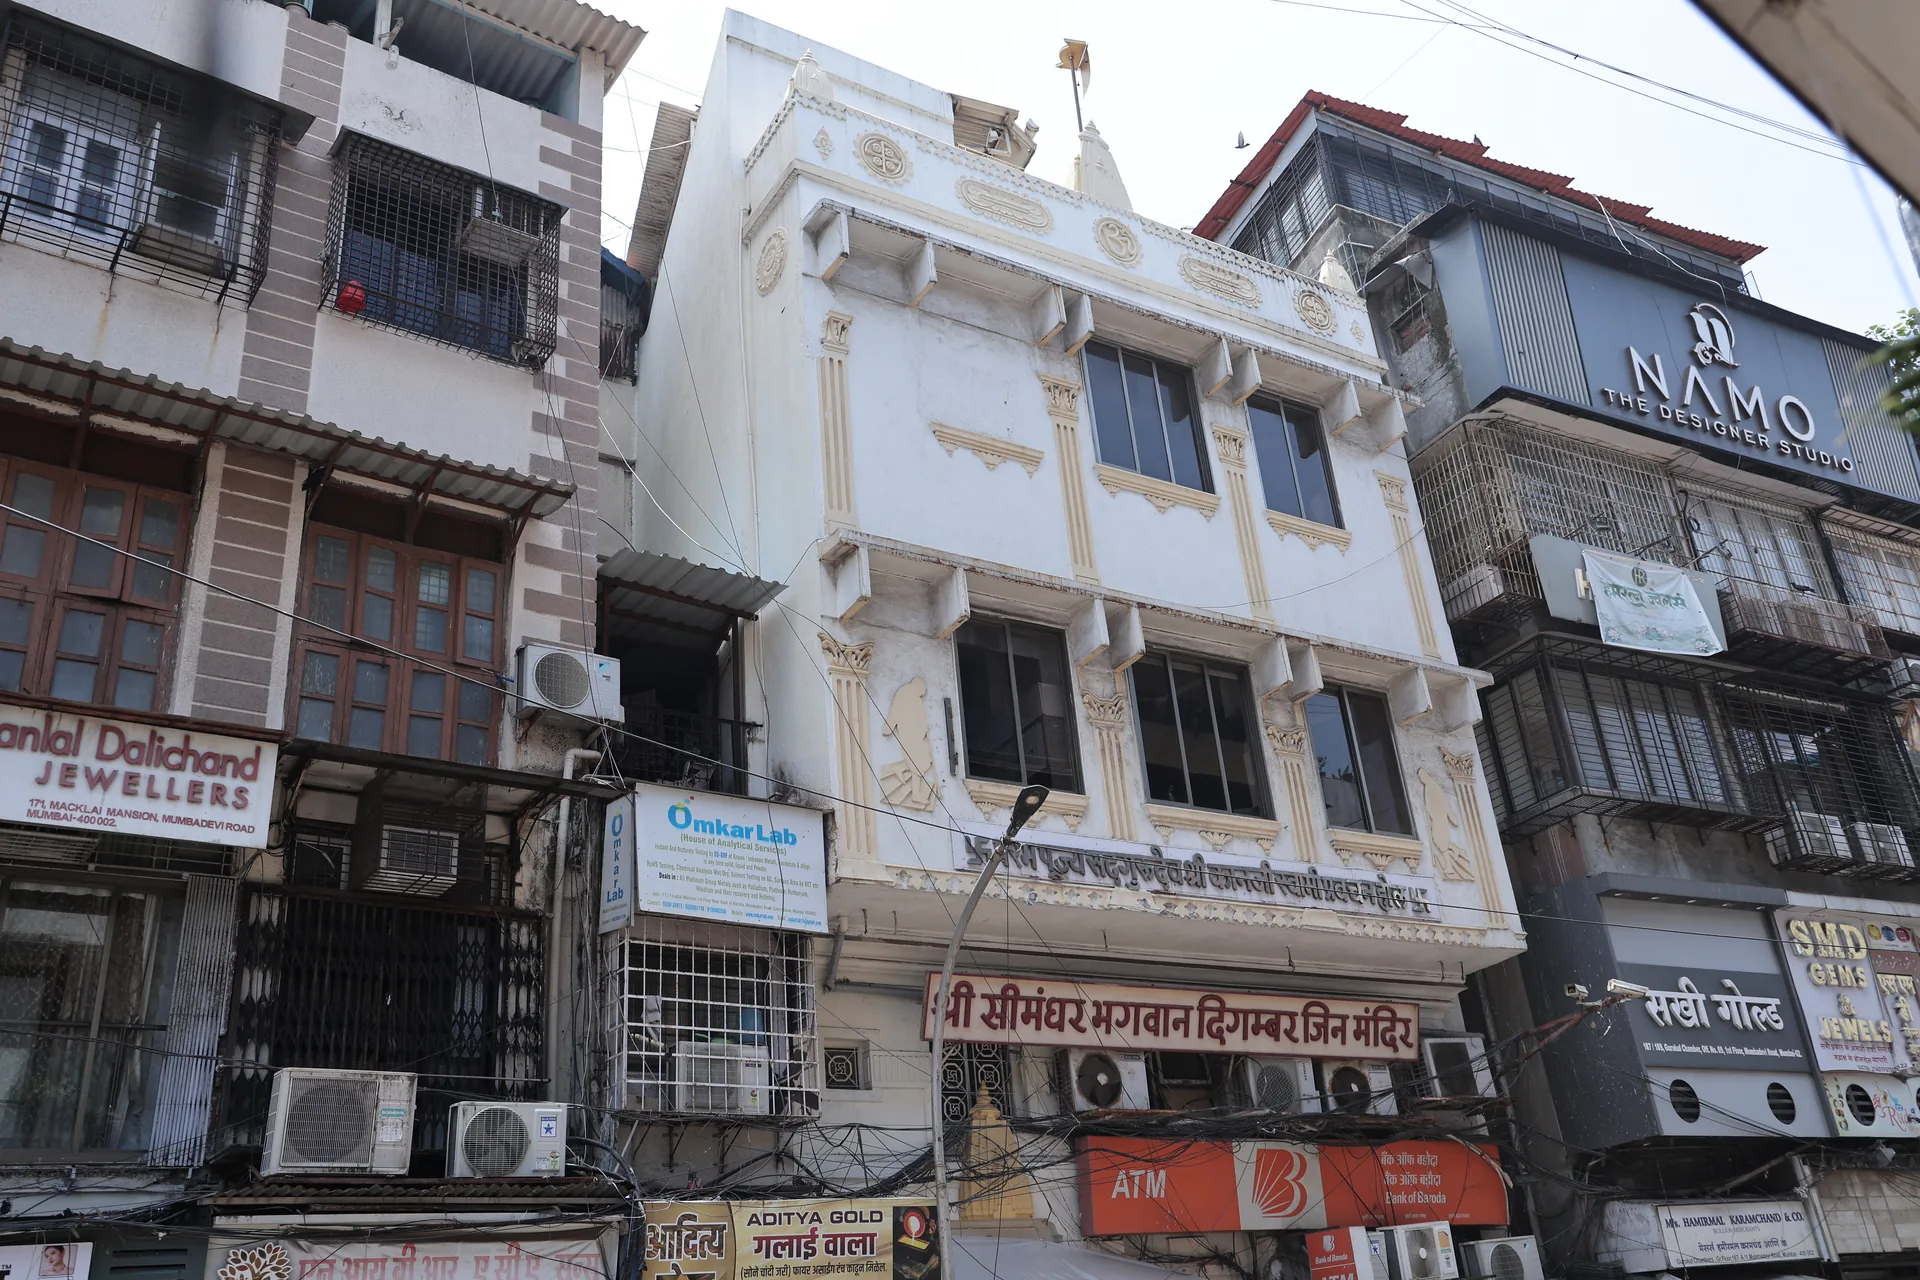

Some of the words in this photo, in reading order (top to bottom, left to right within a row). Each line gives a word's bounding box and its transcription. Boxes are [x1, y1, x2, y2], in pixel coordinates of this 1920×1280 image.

[1626, 346, 1815, 442] NAMO
[1601, 387, 1651, 414] THE
[1657, 404, 1771, 449] DESIGNER
[1779, 439, 1854, 472] STUDIO
[95, 724, 262, 781] Dalichand
[34, 760, 250, 810] JEWELLERS
[29, 798, 47, 810] 171,
[49, 800, 103, 815] MACKLAI
[106, 807, 160, 823] MANSION,
[161, 814, 225, 830] MUMBADEVI
[225, 822, 255, 834] ROAD
[667, 802, 754, 840] Omkar
[756, 823, 797, 846] Lab
[680, 833, 705, 844] (House
[708, 837, 715, 845] of
[717, 837, 753, 850] Analytical
[754, 842, 787, 856] Services)
[658, 872, 671, 880] Deals
[1183, 852, 1207, 889] श्री
[1207, 859, 1275, 895] कानजी
[1274, 865, 1324, 901] स्वामी
[606, 887, 624, 903] Lab
[1786, 919, 1867, 960] SMD
[1807, 962, 1868, 989] GEMS
[932, 981, 976, 1028] श्री
[980, 983, 1087, 1034] सीमंधर
[1091, 999, 1194, 1038] भगवान
[1197, 994, 1299, 1046] दिगम्बर
[1301, 1000, 1349, 1046] जिन
[1353, 1005, 1414, 1052] मंदिर
[1645, 976, 1711, 1029] सखी
[1710, 979, 1784, 1032] गोल्ड
[1838, 992, 1857, 1016] &
[1818, 1015, 1893, 1043] JEWELS
[1743, 1047, 1768, 1056] Mumbadevi
[1767, 1048, 1780, 1058] Road,
[1112, 1168, 1167, 1200] ATM
[1385, 1191, 1407, 1204] Bank
[1408, 1190, 1417, 1204] of
[1417, 1190, 1447, 1204] Baroda
[747, 1211, 823, 1226] ADITYA
[830, 1210, 884, 1224] GOLD
[1683, 1215, 1726, 1228] HAMIRMAL
[1729, 1213, 1782, 1226] KARAMCHAND
[1784, 1212, 1792, 1223] &
[1791, 1211, 1805, 1222] CO.
[646, 1213, 728, 1260] आदित्य
[753, 1226, 819, 1260] गलाई
[822, 1232, 878, 1257] वाला
[1764, 1237, 1779, 1248] आणि
[740, 1266, 759, 1279] (सोने
[760, 1264, 774, 1277] चांदी
[775, 1264, 791, 1277] जरी)
[792, 1265, 811, 1276] फायर
[846, 1263, 865, 1276] काढून
[1315, 1256, 1326, 1264] Bank
[1331, 1253, 1348, 1262] Baroda
